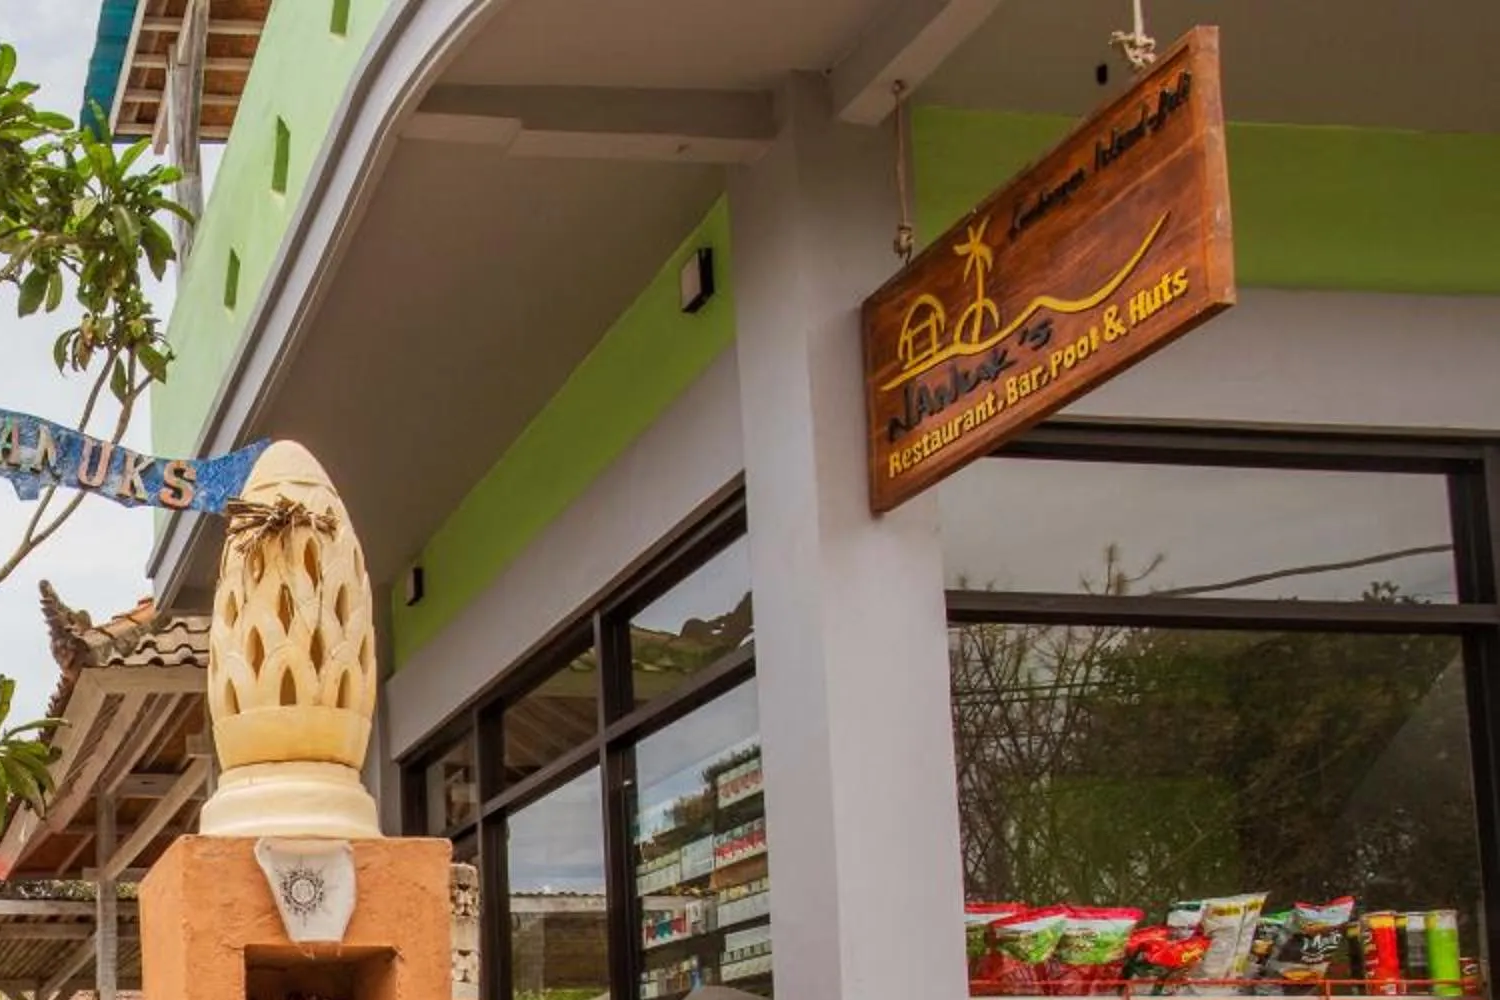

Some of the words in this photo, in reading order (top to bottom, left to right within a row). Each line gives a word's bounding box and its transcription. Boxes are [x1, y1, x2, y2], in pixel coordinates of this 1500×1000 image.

[1049, 326, 1100, 378] Pool
[1103, 304, 1128, 343] &
[1128, 266, 1190, 325] Huts
